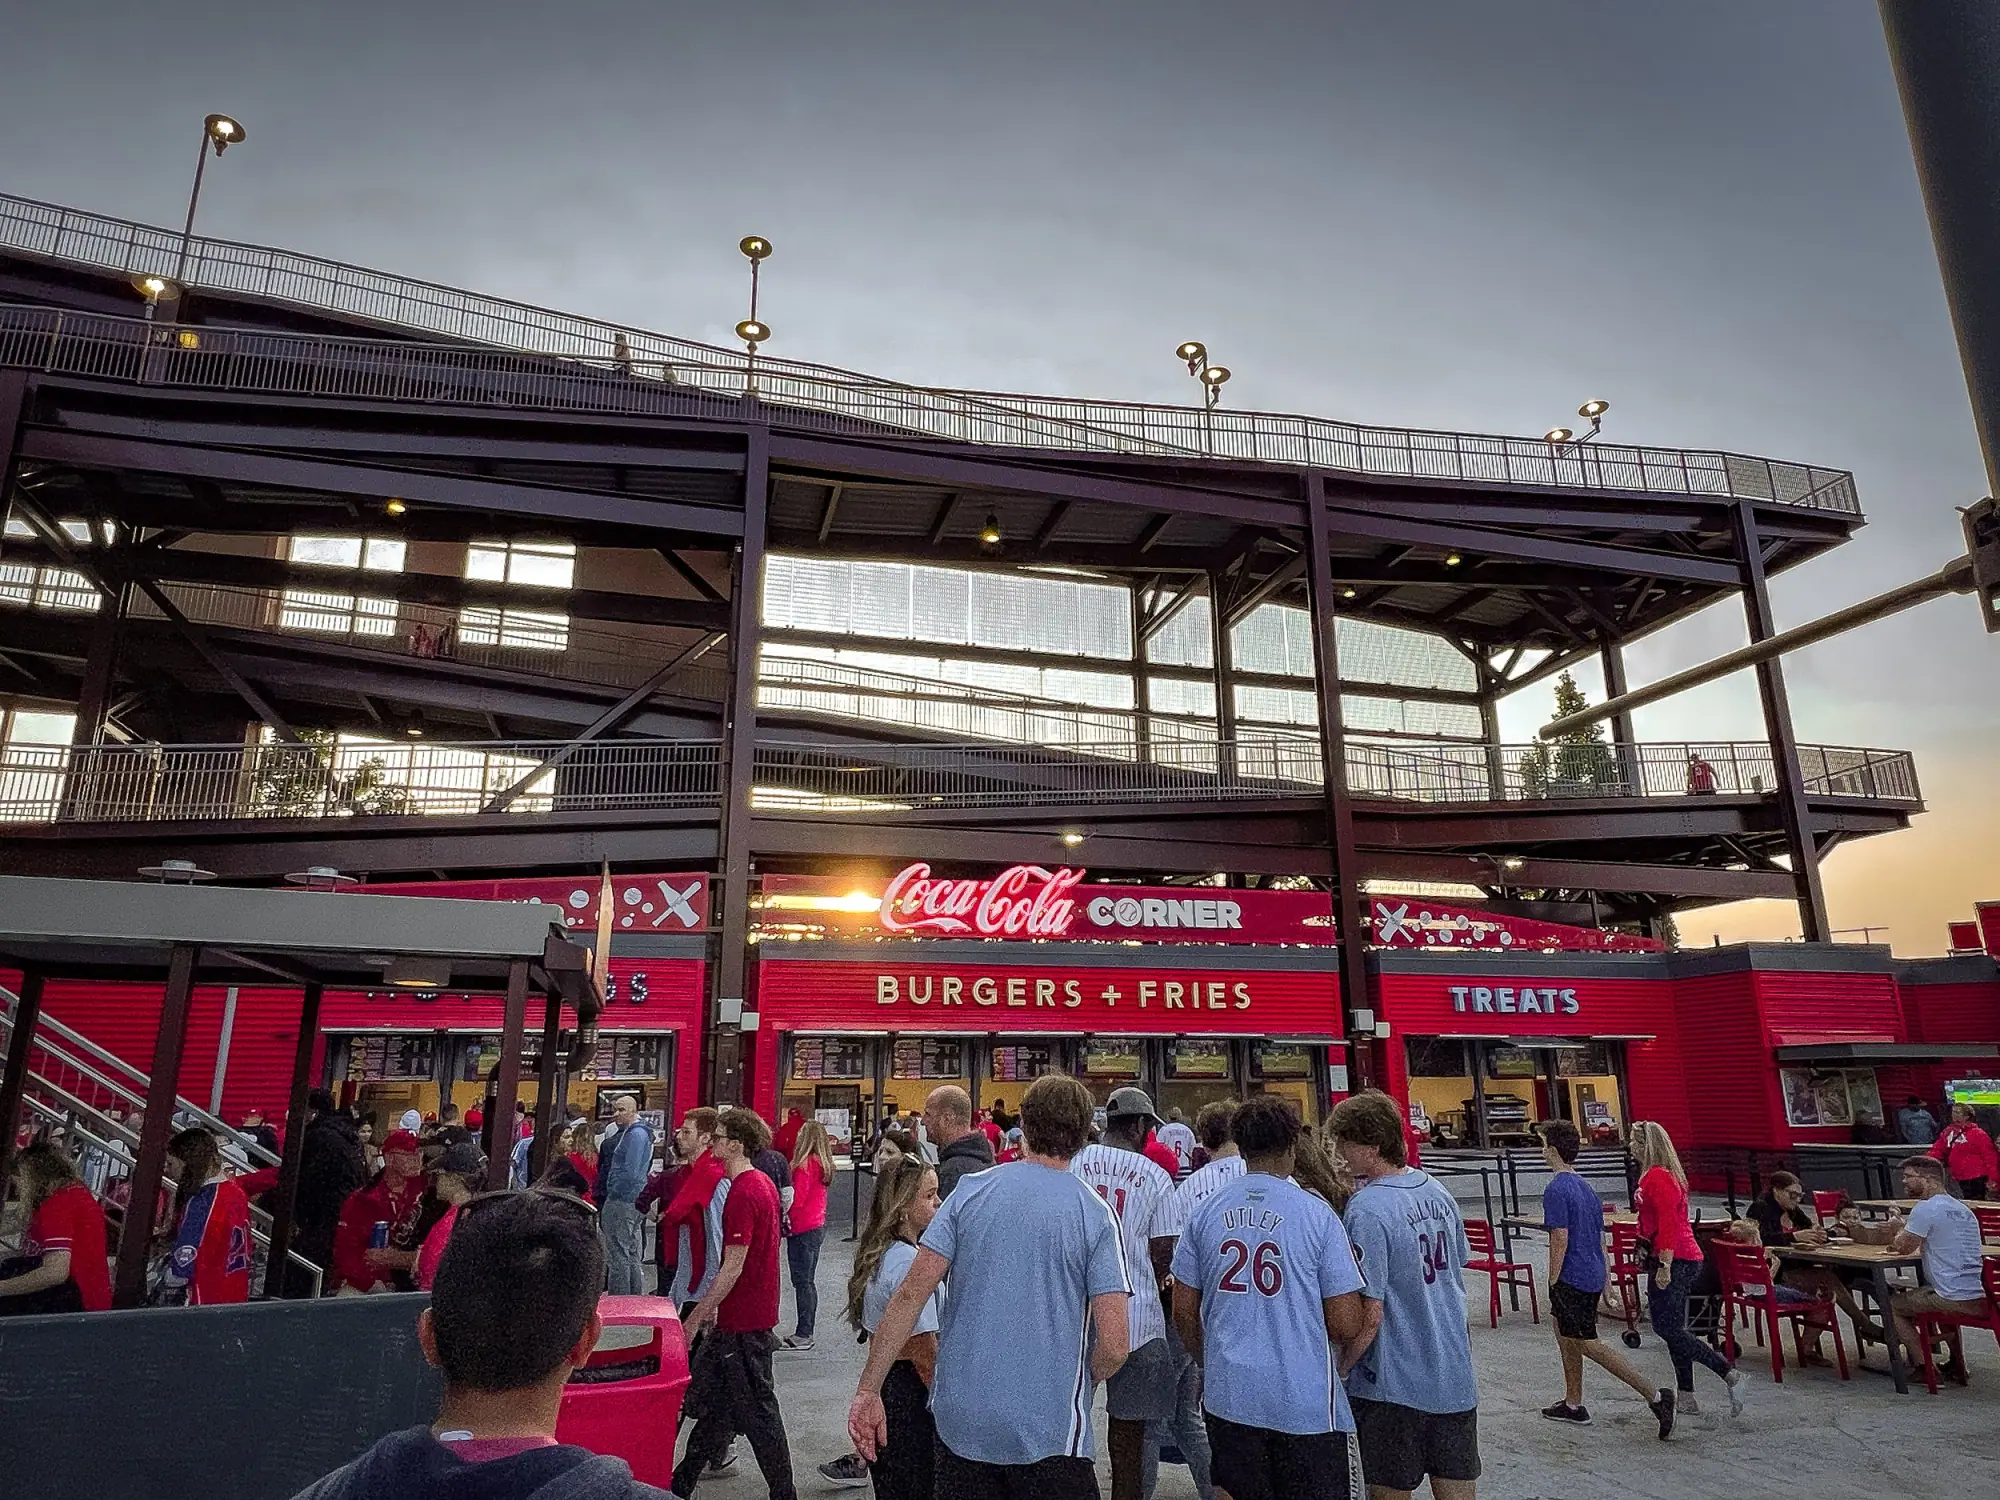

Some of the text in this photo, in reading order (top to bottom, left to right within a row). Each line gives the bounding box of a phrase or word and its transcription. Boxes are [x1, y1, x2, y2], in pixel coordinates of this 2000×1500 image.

[879, 862, 1243, 935] Coca-Cola CORNER
[876, 975, 1252, 1010] BURGERS + FRIES
[1447, 986, 1580, 1014] TREATS
[1083, 1162, 1147, 1188] ROLLINS
[1223, 1206, 1285, 1234] UTLEY
[1217, 1238, 1284, 1298] 26
[1418, 1230, 1449, 1286] 34
